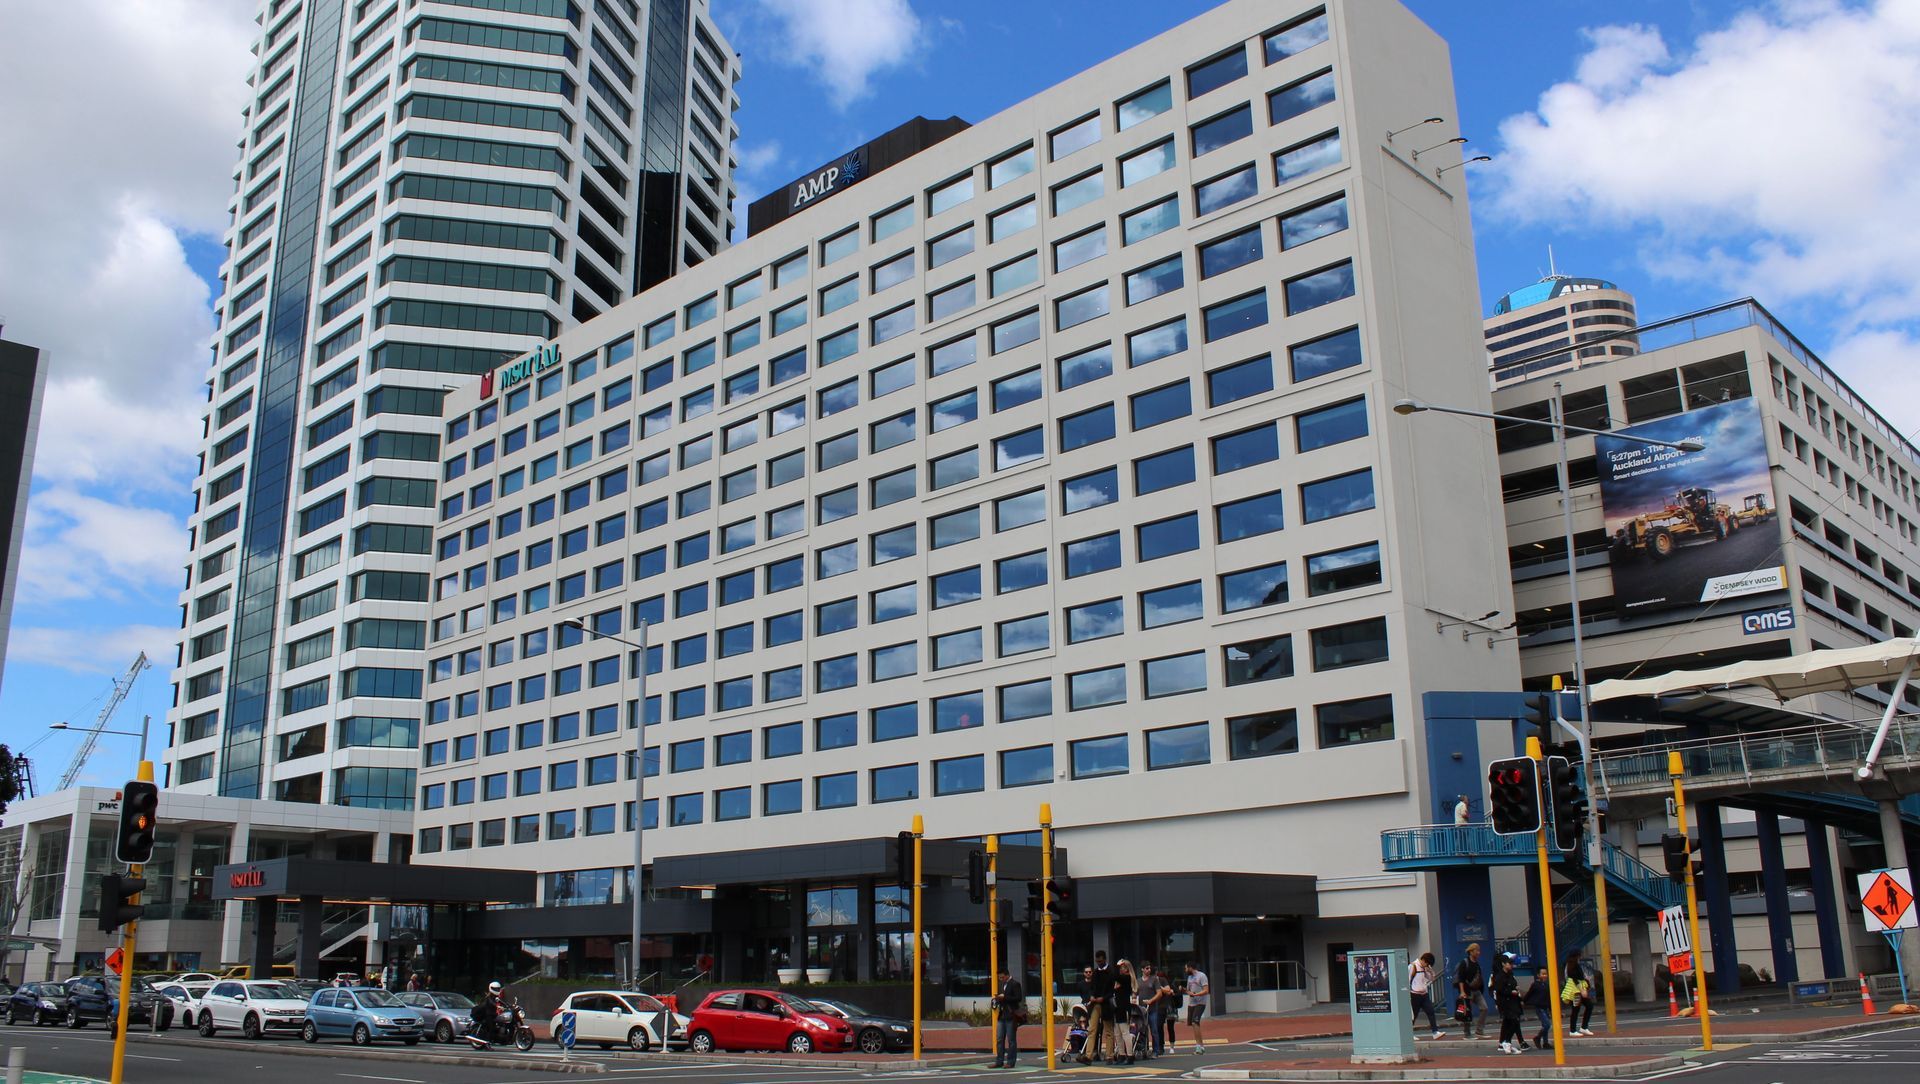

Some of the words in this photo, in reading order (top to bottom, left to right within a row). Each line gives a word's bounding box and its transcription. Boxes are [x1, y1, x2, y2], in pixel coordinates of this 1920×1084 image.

[794, 167, 839, 207] AMP
[1611, 450, 1641, 462] 5:27pm
[1648, 445, 1664, 454] The
[1612, 456, 1652, 472] Auckland
[1720, 579, 1754, 591] DEMPSEY
[1755, 575, 1777, 585] WOOD
[98, 802, 119, 810] pwc
